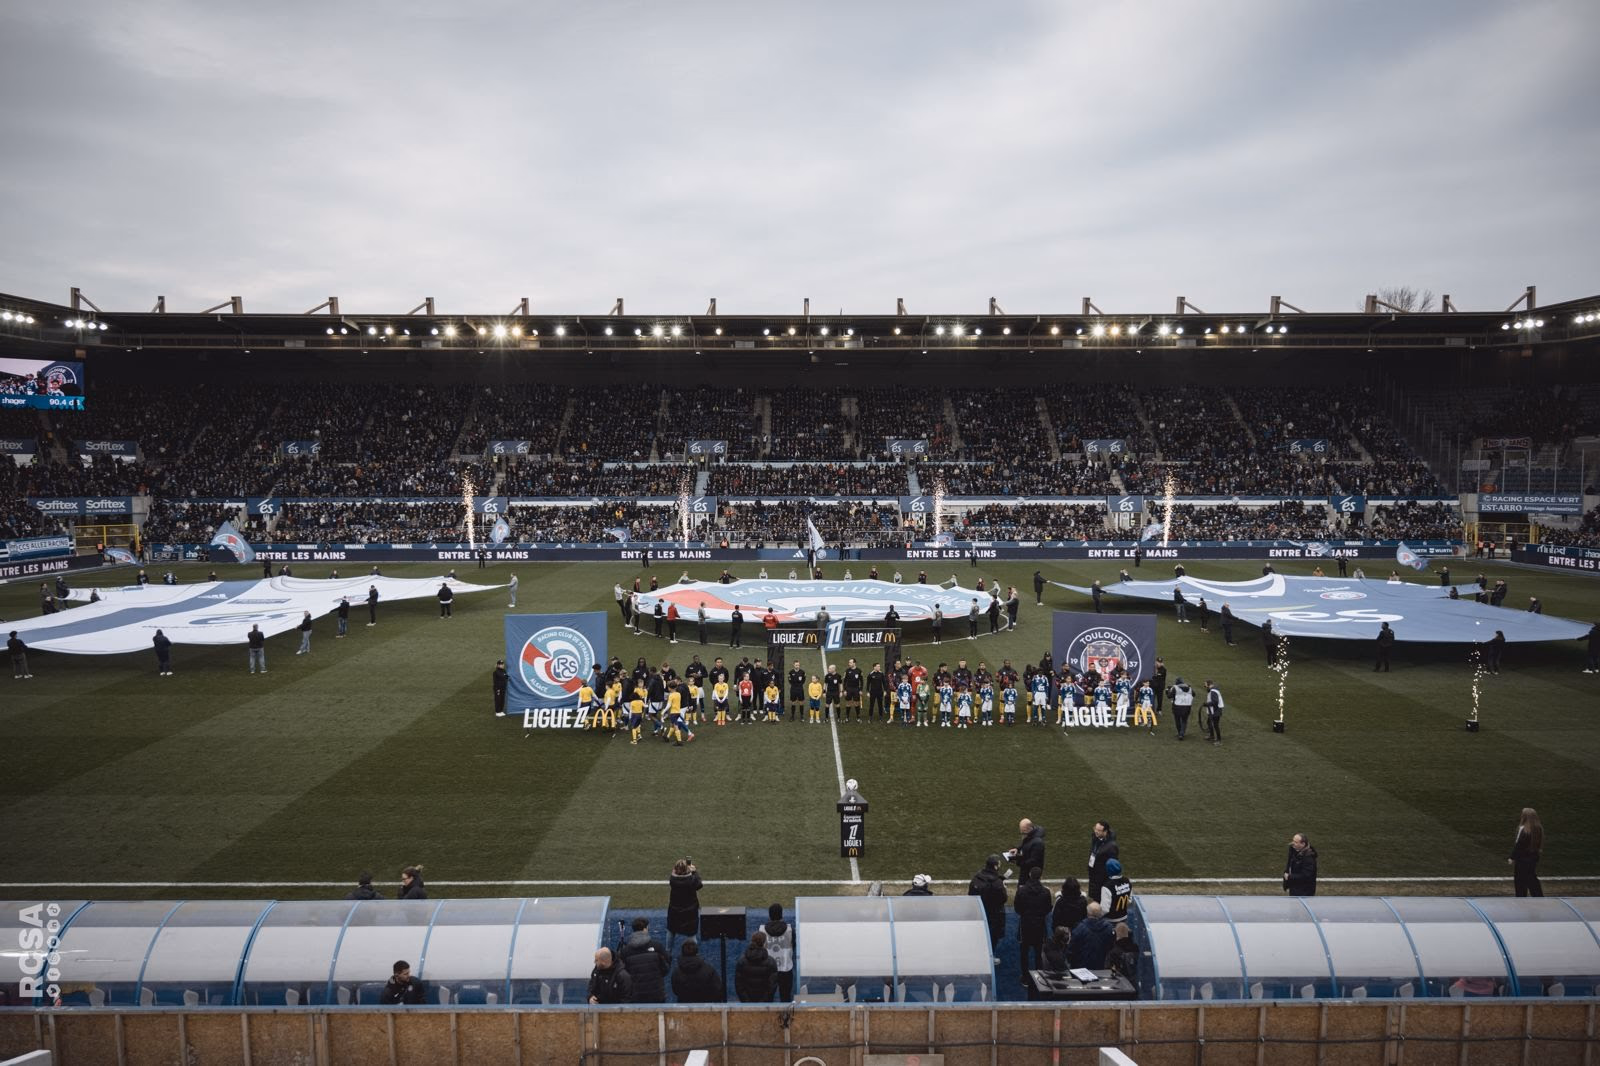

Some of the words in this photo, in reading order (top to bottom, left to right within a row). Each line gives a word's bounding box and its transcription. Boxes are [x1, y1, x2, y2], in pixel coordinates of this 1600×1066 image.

[37, 500, 78, 510] Sofitex
[86, 500, 125, 509] Sofitex
[0, 566, 20, 576] NTRE
[24, 564, 39, 574] LES
[42, 560, 69, 571] MAINS
[1549, 556, 1575, 566] ENTRE
[1579, 559, 1594, 569] LES
[731, 586, 815, 597] RACING
[824, 586, 883, 594] CLUB
[537, 631, 557, 642] RACING
[773, 633, 796, 643] LIGUE
[852, 633, 875, 643] LIGUE
[1080, 632, 1129, 648] TOULOUSE
[530, 679, 548, 692] ALSACE
[523, 708, 572, 728] LIGUE
[1064, 706, 1114, 727] LIGUE
